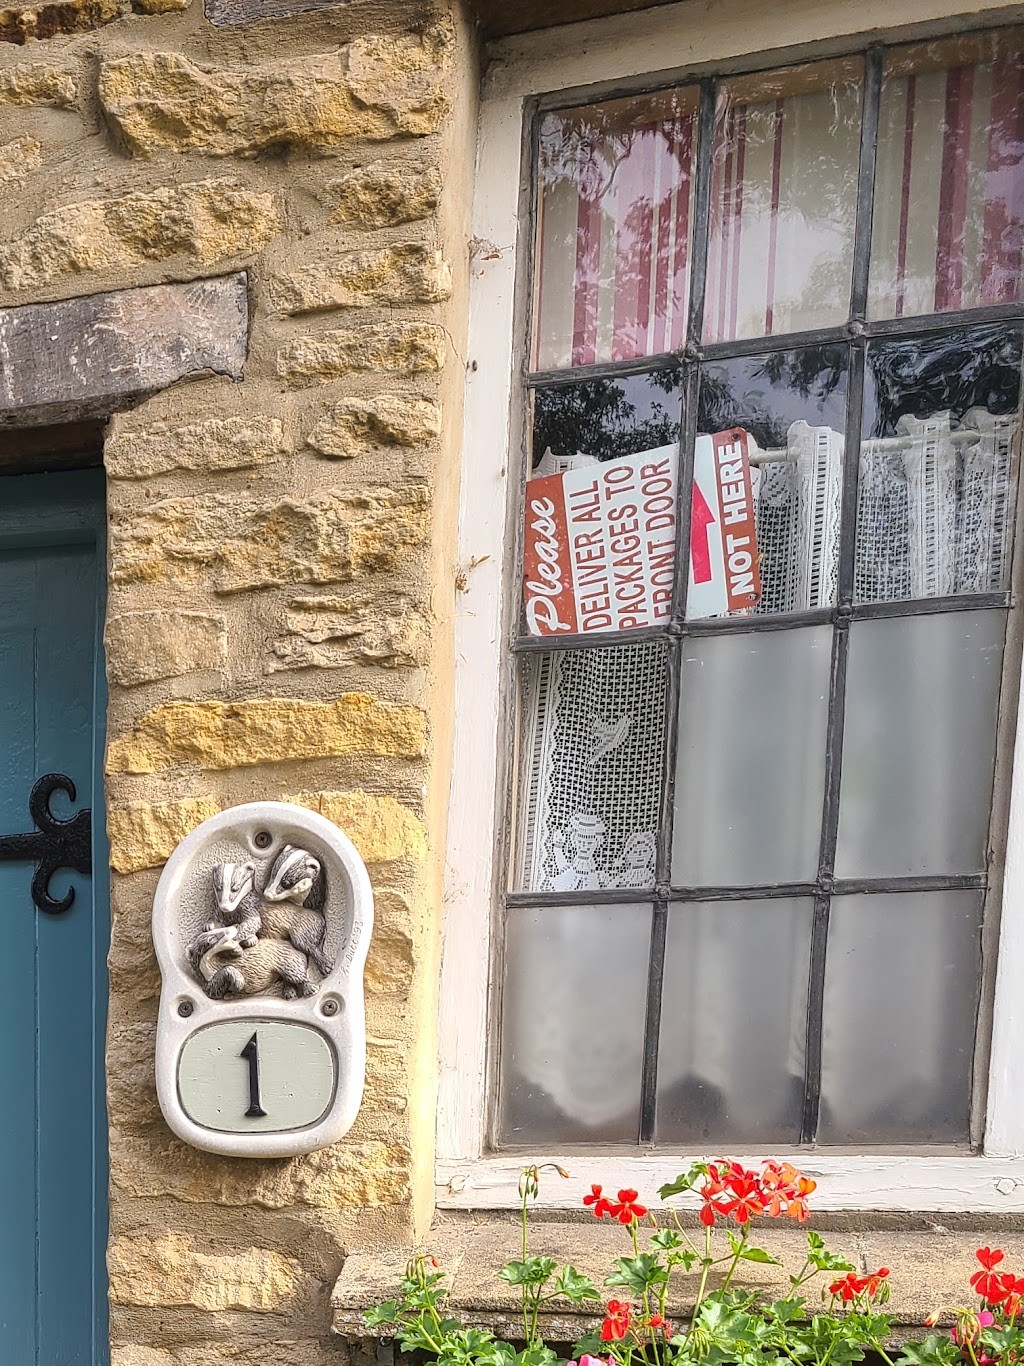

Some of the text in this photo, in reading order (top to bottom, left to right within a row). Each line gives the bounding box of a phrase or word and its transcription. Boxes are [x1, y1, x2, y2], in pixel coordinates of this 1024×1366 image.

[526, 496, 571, 636] Please
[569, 480, 612, 631] DELIVER ALL
[603, 466, 649, 630] PACKAGES TO
[640, 458, 676, 618] FRONT DOOR
[718, 441, 755, 596] NOT HERE
[239, 1030, 268, 1118] 1
